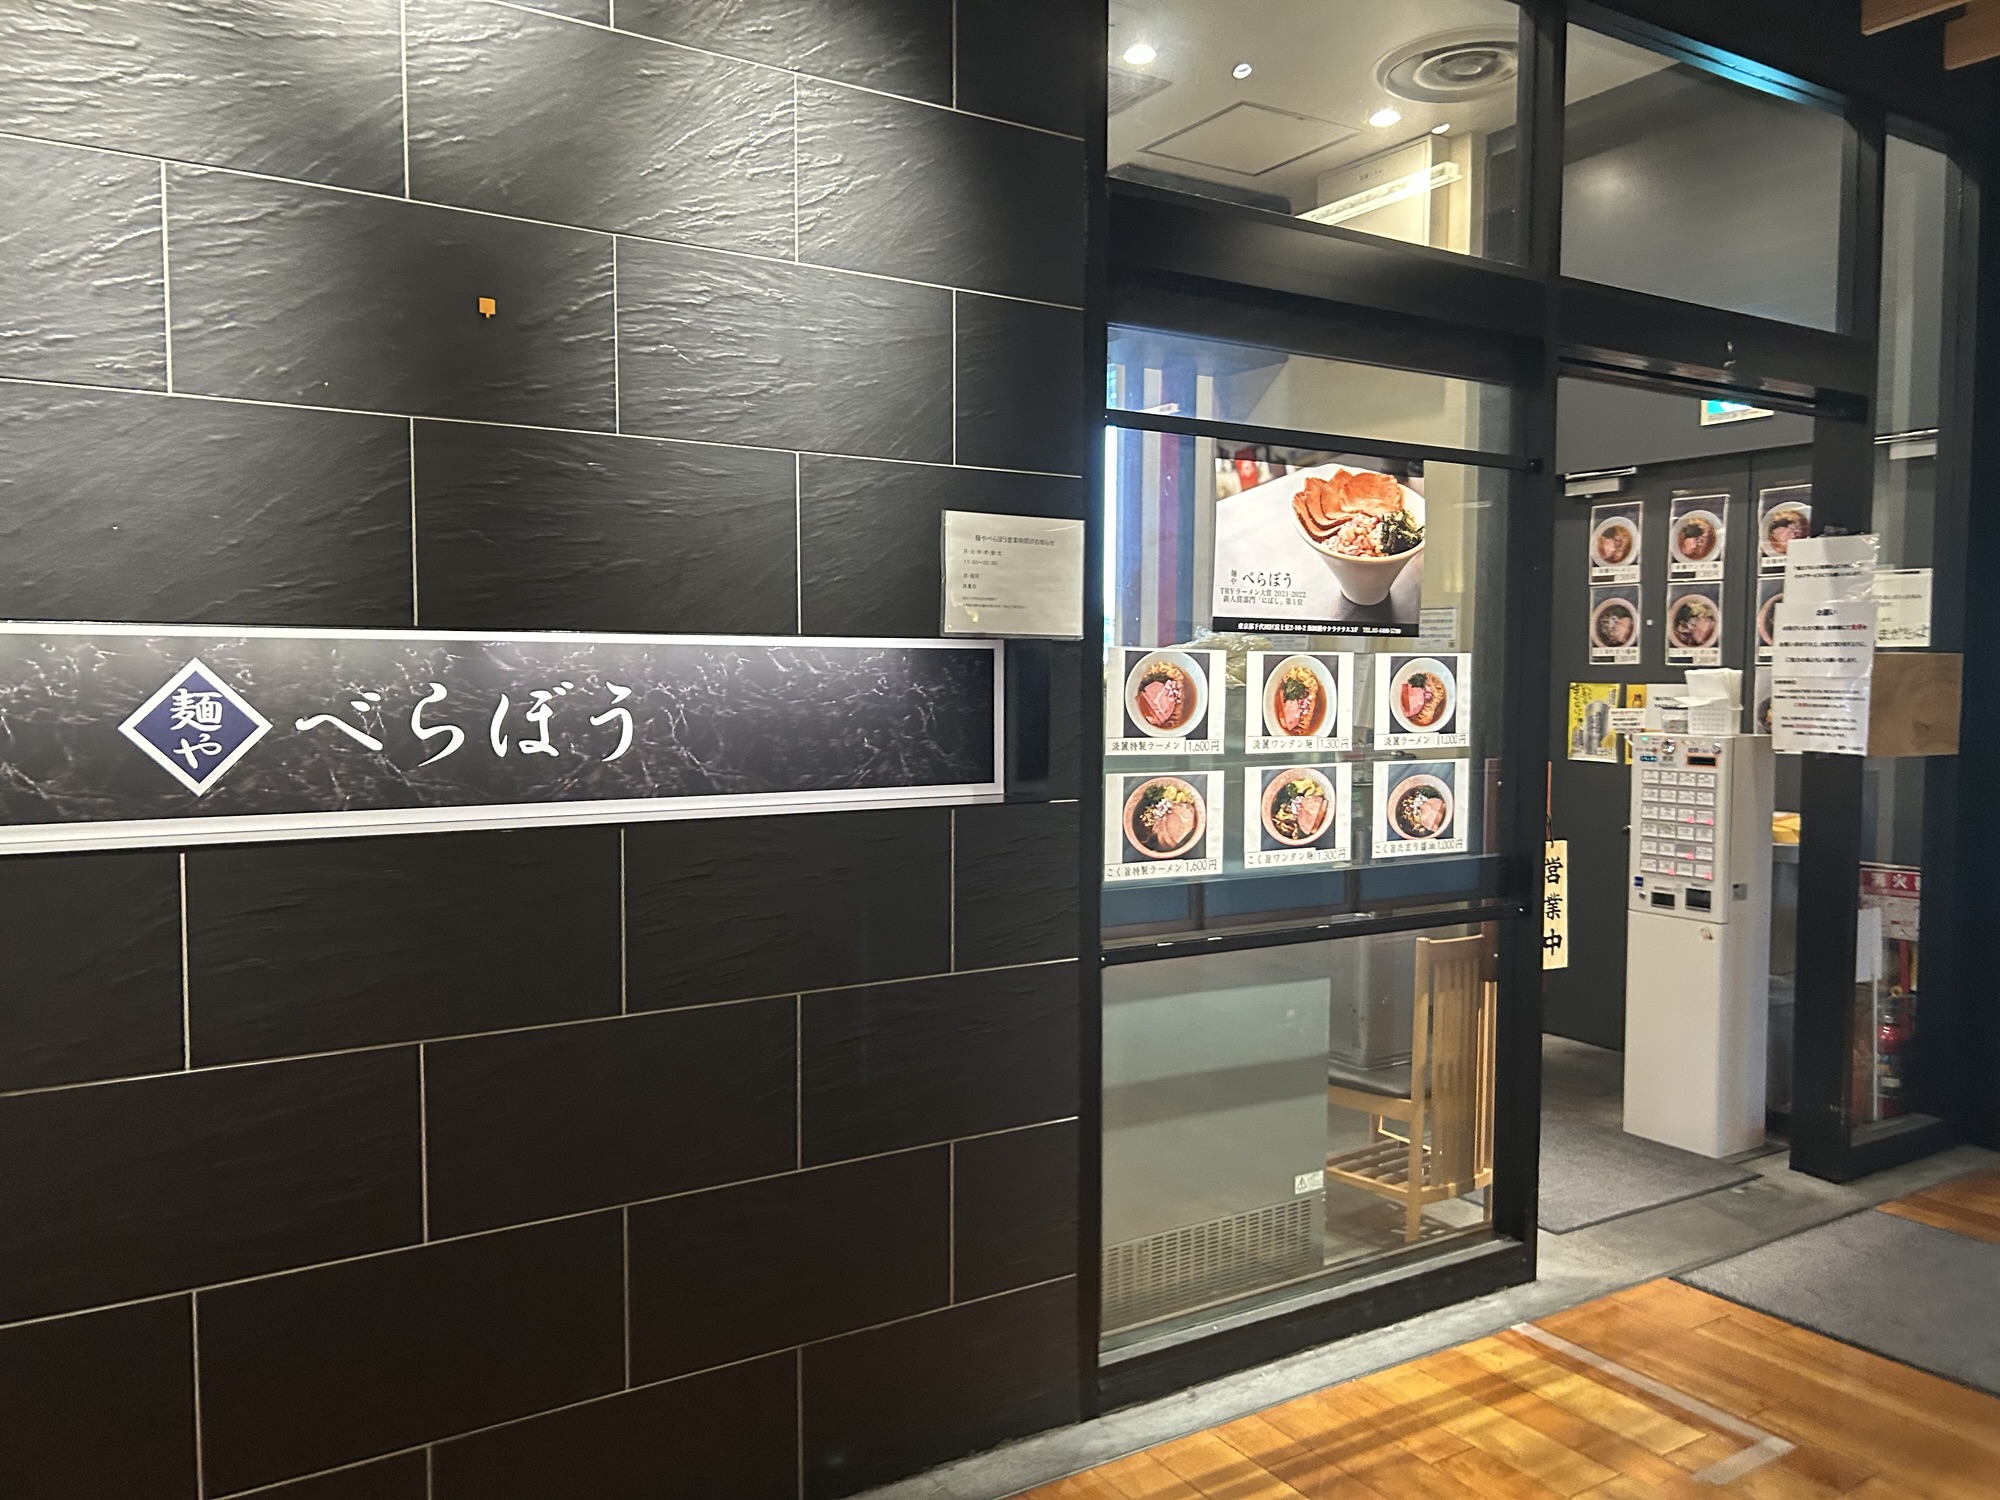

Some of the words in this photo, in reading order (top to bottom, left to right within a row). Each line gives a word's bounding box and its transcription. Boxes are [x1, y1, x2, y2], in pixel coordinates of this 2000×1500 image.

[1242, 571, 1292, 588] べらぼう
[170, 687, 224, 769] 麺や
[295, 681, 635, 768] べらぼう
[1111, 741, 1180, 752] 淡麗特製ラーメン
[1188, 740, 1220, 752] 1,600円
[1320, 738, 1349, 749] 1,300円
[1317, 848, 1346, 861] 1,300円
[1107, 863, 1182, 877] こく旨特製ラーメン
[1185, 858, 1217, 872] 1,600円
[1543, 856, 1564, 956] 営業中
